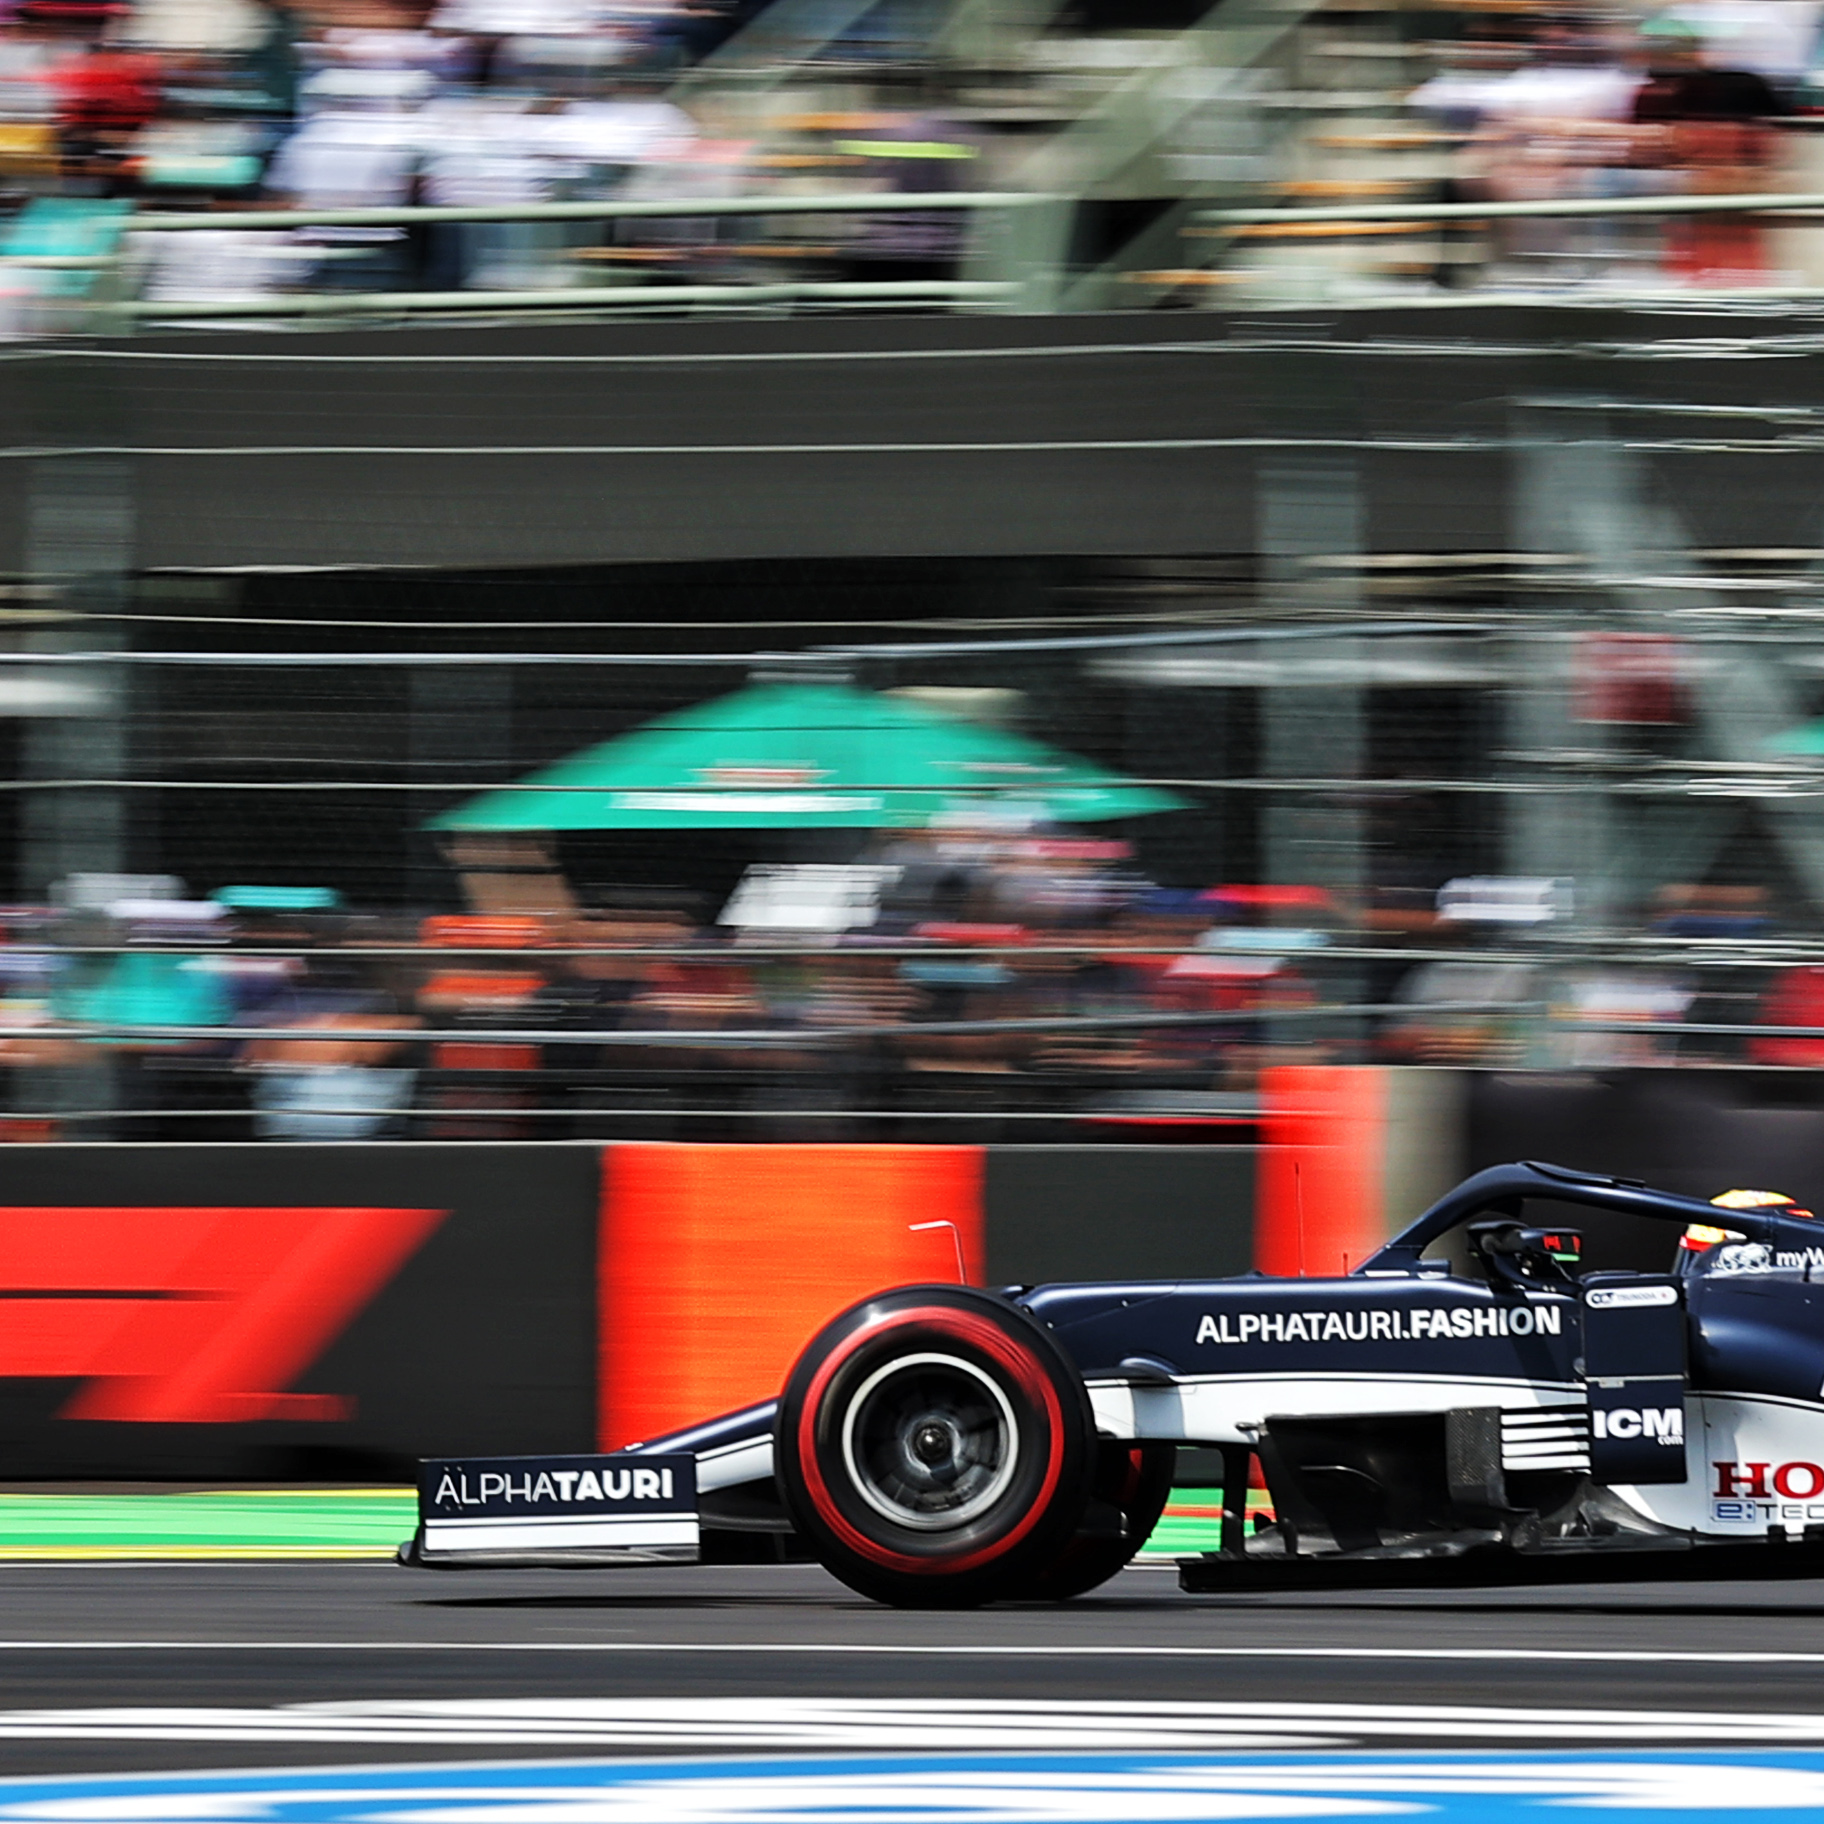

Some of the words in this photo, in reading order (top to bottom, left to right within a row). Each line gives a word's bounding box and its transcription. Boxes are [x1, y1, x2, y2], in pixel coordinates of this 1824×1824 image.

[1195, 1305, 1561, 1345] ALPHATAURI.FASHION
[1592, 1407, 1684, 1439] ICM
[434, 1468, 674, 1505] ALPHATAURI
